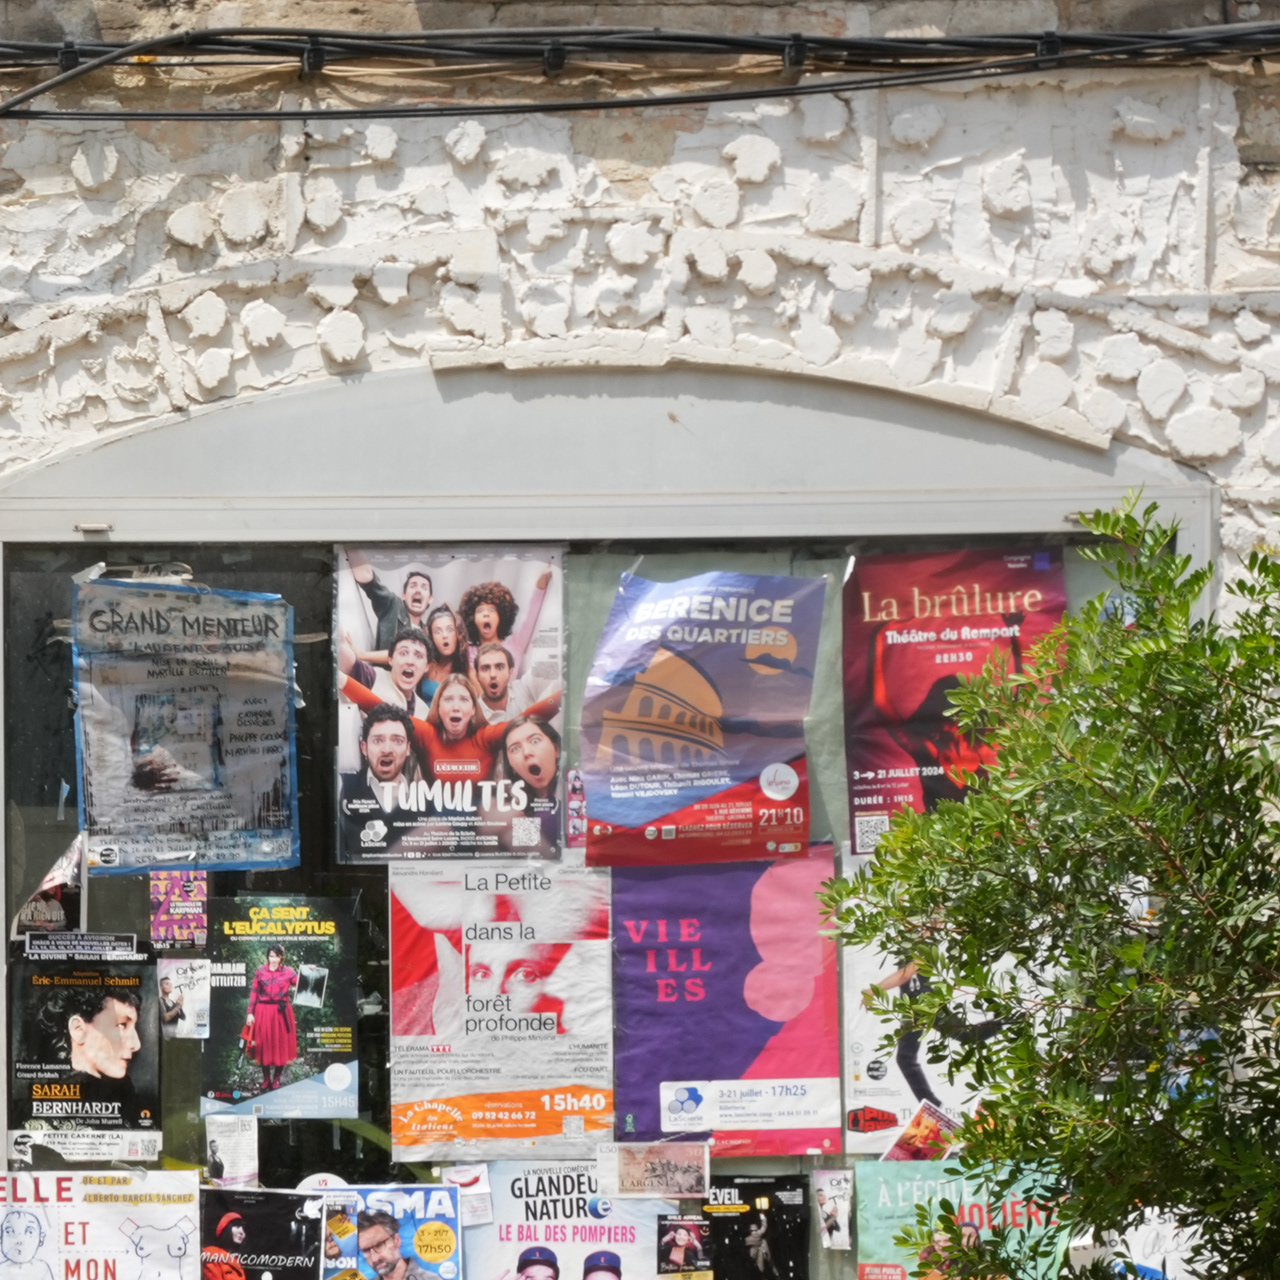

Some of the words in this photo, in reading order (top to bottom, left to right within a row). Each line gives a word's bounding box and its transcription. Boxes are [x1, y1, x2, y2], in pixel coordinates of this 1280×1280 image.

[633, 594, 796, 624] BERENICE
[861, 591, 900, 623] La
[912, 583, 1043, 619] brûlure
[90, 607, 172, 635] GRAND
[181, 611, 280, 639] MENTEUR
[625, 625, 661, 641] DES
[666, 625, 790, 646] QUARTIERS
[884, 629, 937, 645] Théâtre
[940, 628, 957, 641] du
[961, 623, 1021, 641] Rempart
[378, 778, 529, 813] TUMULTES
[853, 794, 884, 806] DURÉE
[893, 794, 914, 804] 1H15
[758, 807, 804, 826] 21H10
[464, 873, 489, 891] La
[494, 872, 552, 891] Petite
[248, 906, 270, 922] ÇA
[271, 906, 310, 920] SENT
[223, 920, 336, 935] L'EUCALYPTUS
[464, 923, 514, 941] dans
[519, 922, 536, 940] la
[622, 917, 702, 944] VIE
[645, 947, 713, 973] ILL
[104, 976, 140, 986] Schmitt
[656, 977, 707, 1003] ES
[465, 994, 512, 1013] forêt
[465, 1013, 556, 1036] profonde
[32, 1083, 81, 1097] SARAH
[718, 1089, 737, 1099] 3-21
[739, 1088, 763, 1100] juillet
[770, 1084, 808, 1097] 17h25
[32, 1101, 122, 1115] BERNHARDT
[398, 1109, 415, 1124] La
[413, 1100, 464, 1123] Chapelle
[540, 1093, 606, 1111] 15h40
[523, 1168, 532, 1176] LA
[531, 1166, 563, 1176] NOUVELLE
[562, 1164, 590, 1174] COMÉDIE
[510, 1173, 598, 1199] GLANDEU
[708, 1185, 744, 1205] ÉVEIL
[878, 1176, 889, 1208] À
[897, 1173, 974, 1207] L'ÉCOLE
[357, 1190, 456, 1219] SMA
[64, 1221, 90, 1246] ET
[498, 1224, 512, 1242] LE
[517, 1224, 540, 1243] BAL
[544, 1224, 568, 1243] DES
[571, 1225, 636, 1244] POMPIERS
[200, 1251, 315, 1268] MANTICOMODERN
[418, 1244, 452, 1255] 17h50
